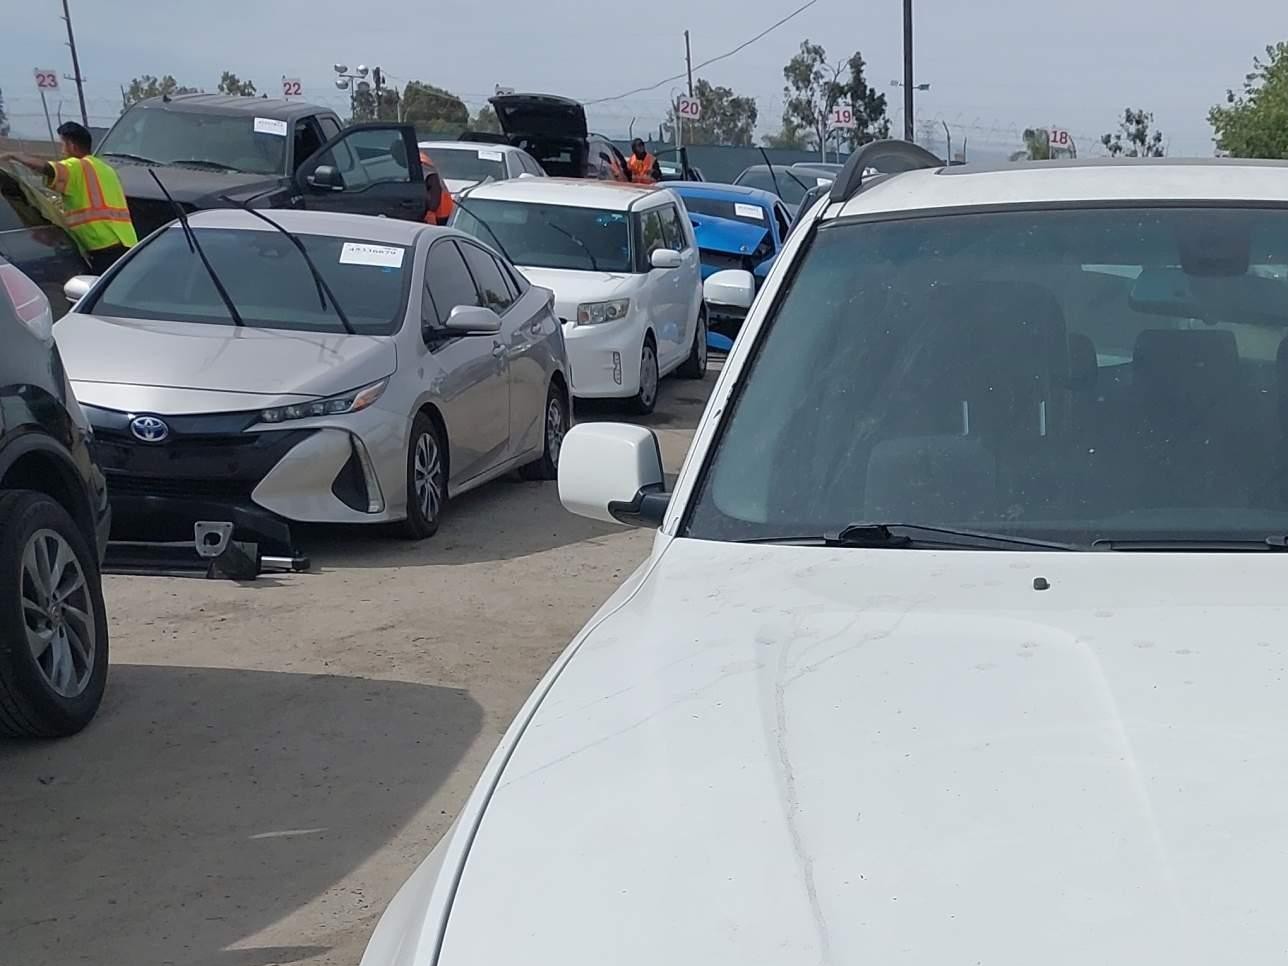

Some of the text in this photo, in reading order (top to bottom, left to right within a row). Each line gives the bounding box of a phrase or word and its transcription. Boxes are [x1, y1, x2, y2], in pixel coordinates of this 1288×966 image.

[36, 74, 58, 88] 23
[282, 82, 301, 96] 22
[680, 100, 698, 115] 20
[834, 110, 850, 123] 19
[1050, 131, 1067, 144] 18
